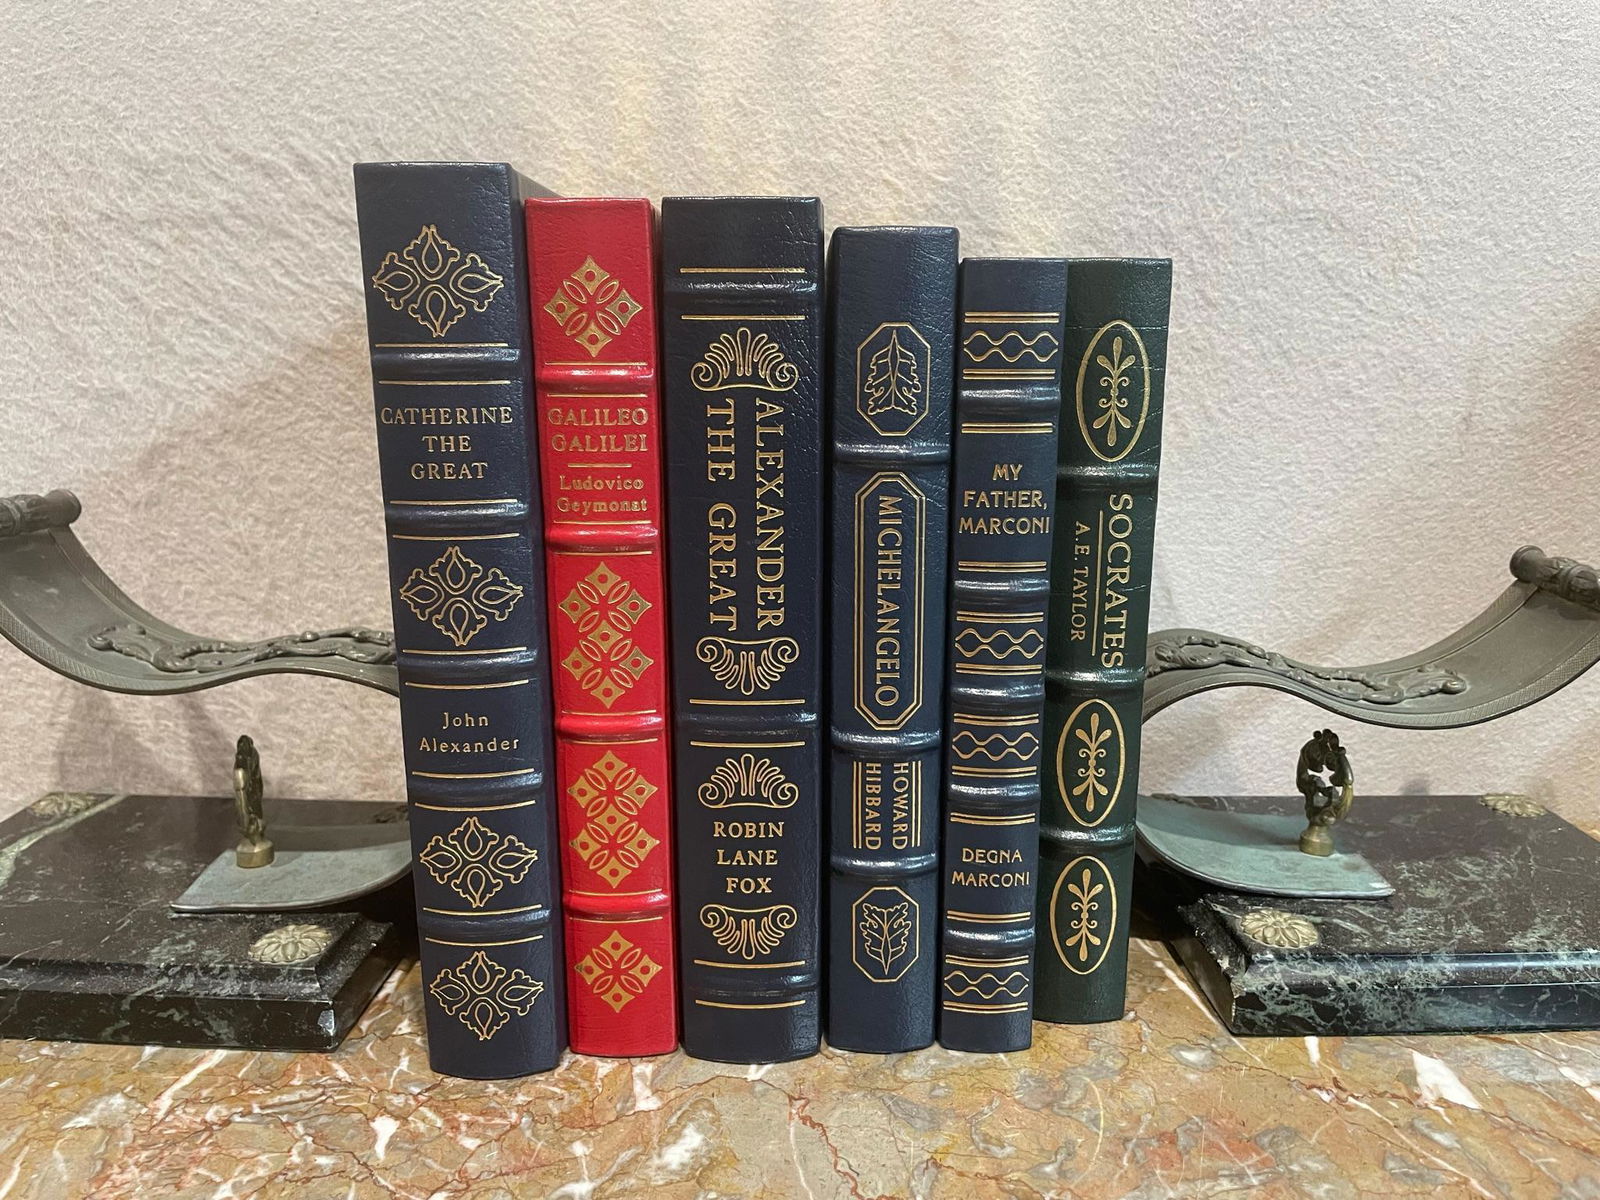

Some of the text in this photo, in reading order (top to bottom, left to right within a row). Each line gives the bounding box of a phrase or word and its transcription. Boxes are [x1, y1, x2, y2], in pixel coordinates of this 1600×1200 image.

[381, 406, 513, 425] CATHERINE
[548, 408, 649, 426] GALILEO
[422, 436, 472, 453] THE
[552, 434, 648, 453] GALILEI
[411, 462, 487, 480] GREAT
[992, 463, 1023, 481] MY
[560, 476, 644, 491] Ludovico
[557, 498, 648, 515] Geymonat
[963, 490, 1048, 510] FATHER,
[706, 397, 737, 631] THE GREAT
[756, 397, 785, 631] ALEXANDER
[958, 517, 1050, 535] MARCONI
[1101, 494, 1133, 668] SOCRATES
[874, 494, 903, 706] MICHELANGELO
[1070, 567, 1088, 641] TAYLOR
[442, 712, 489, 729] John
[420, 737, 520, 753] Alexander
[865, 762, 881, 850] HIBBARD
[892, 762, 909, 850] HOWARD
[713, 821, 784, 838] ROBIN
[717, 849, 778, 866] LANE
[962, 848, 1023, 863] DEGNA
[726, 876, 772, 894] FOX
[951, 870, 1031, 887] MARCONI
